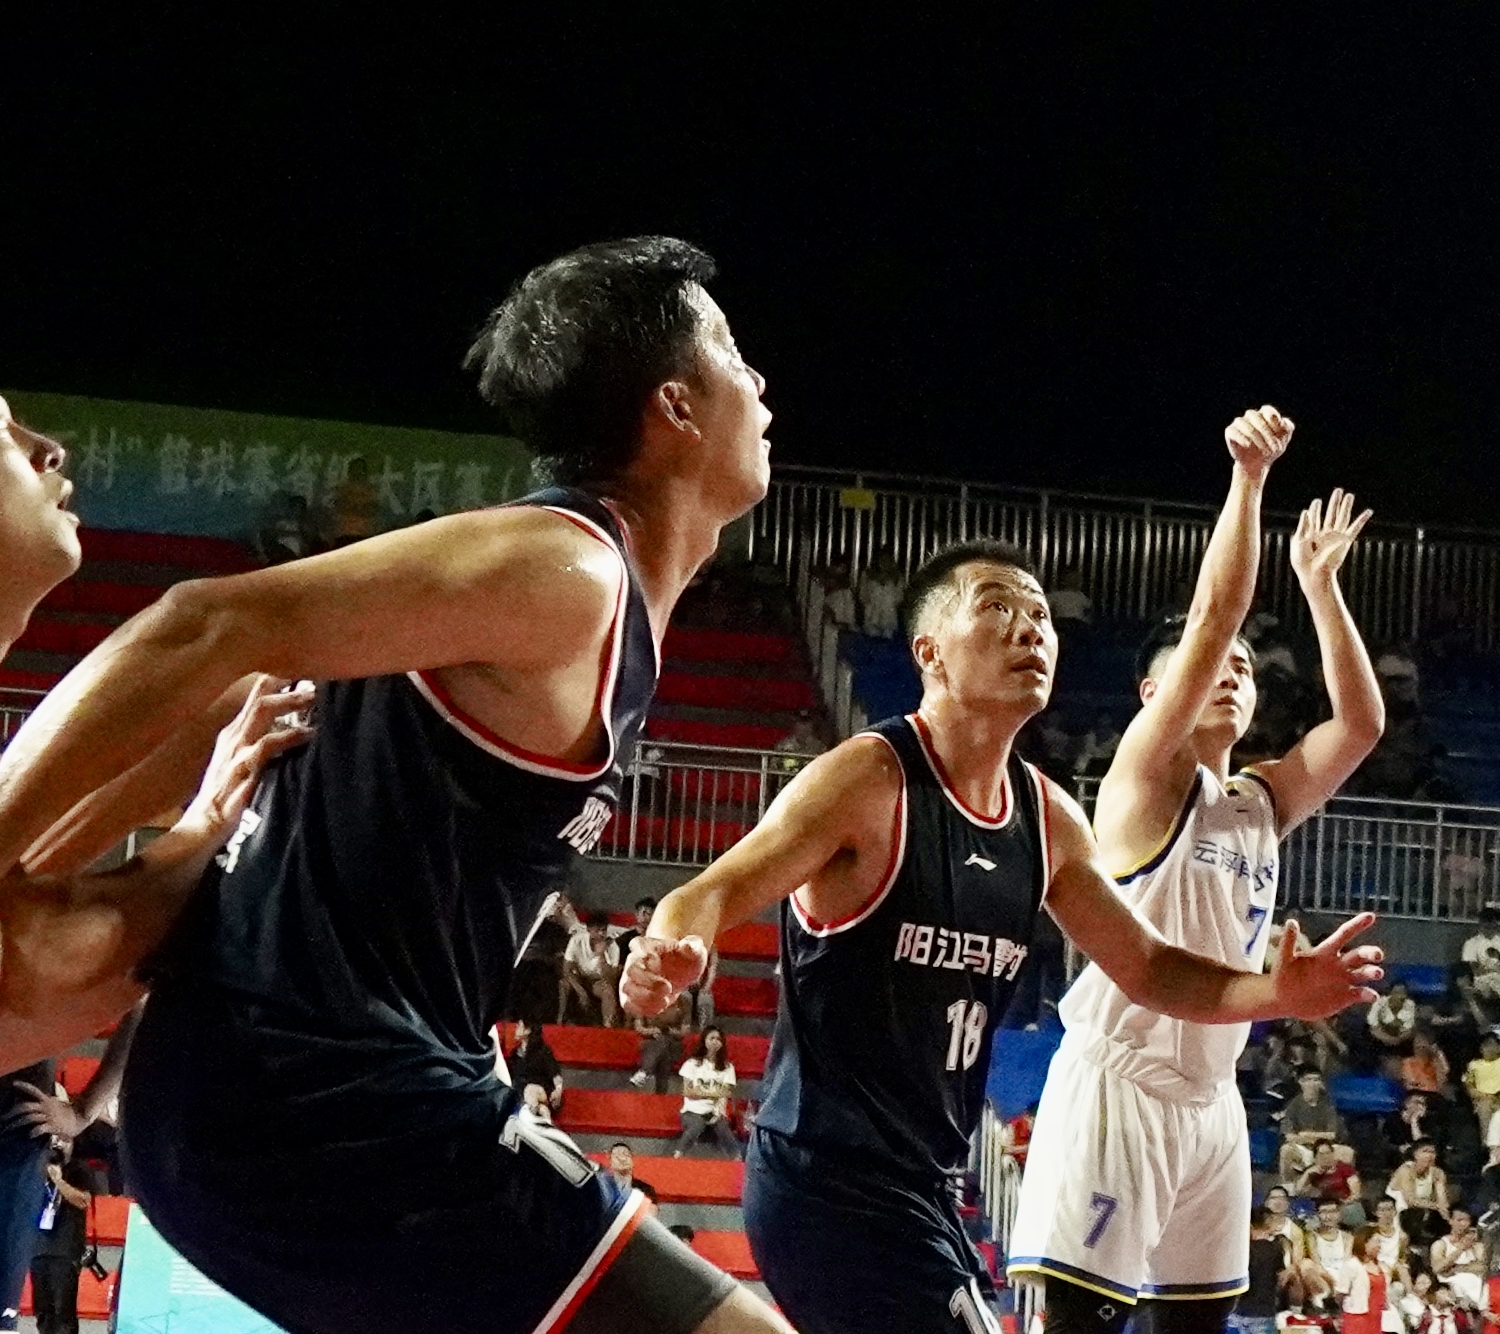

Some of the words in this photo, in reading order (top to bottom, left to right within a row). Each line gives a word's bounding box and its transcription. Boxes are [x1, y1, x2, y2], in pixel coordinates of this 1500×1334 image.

[1246, 903, 1269, 956] 7
[945, 998, 989, 1071] 18
[1083, 1191, 1118, 1249] 7
